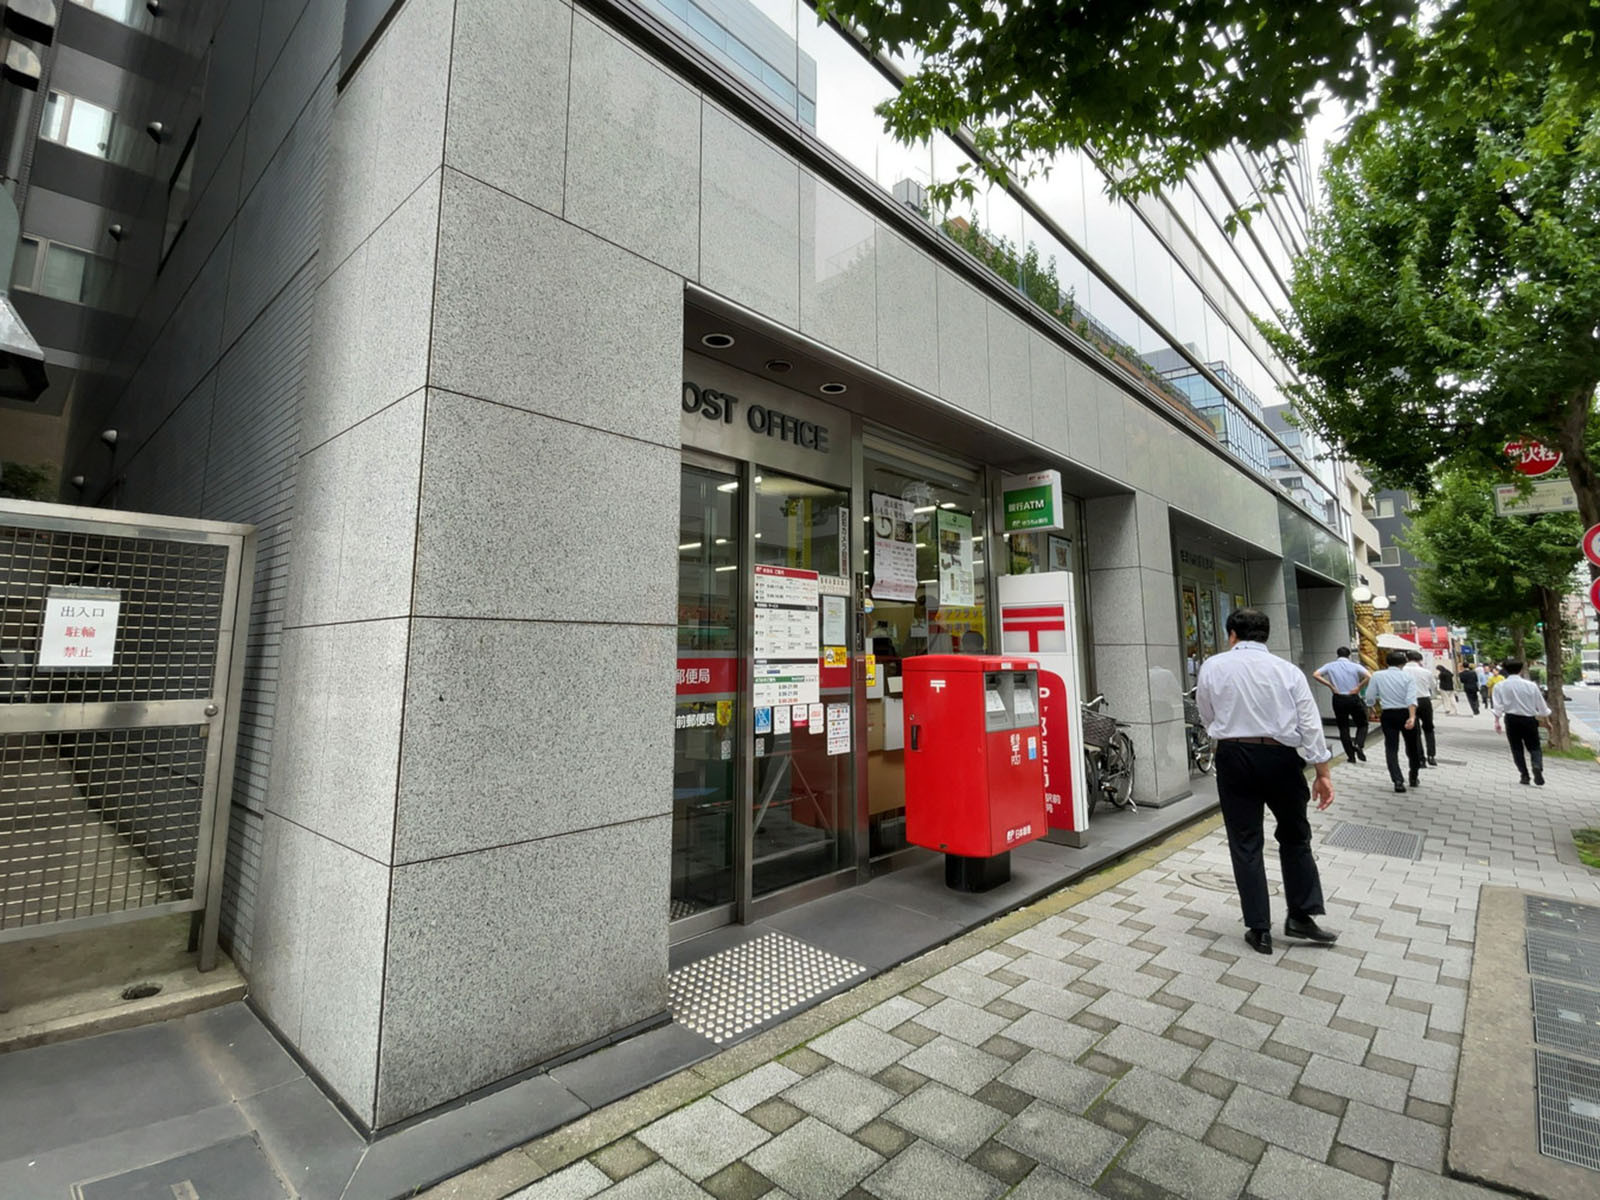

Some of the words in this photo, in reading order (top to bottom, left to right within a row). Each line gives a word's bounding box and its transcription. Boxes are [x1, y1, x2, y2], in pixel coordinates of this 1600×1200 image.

[682, 381, 738, 424] OST
[746, 404, 830, 453] OFFICE
[60, 605, 105, 618] 出入口
[64, 626, 96, 638] 駐輪
[63, 646, 93, 658] 禁止
[676, 713, 716, 729] 前郵便局
